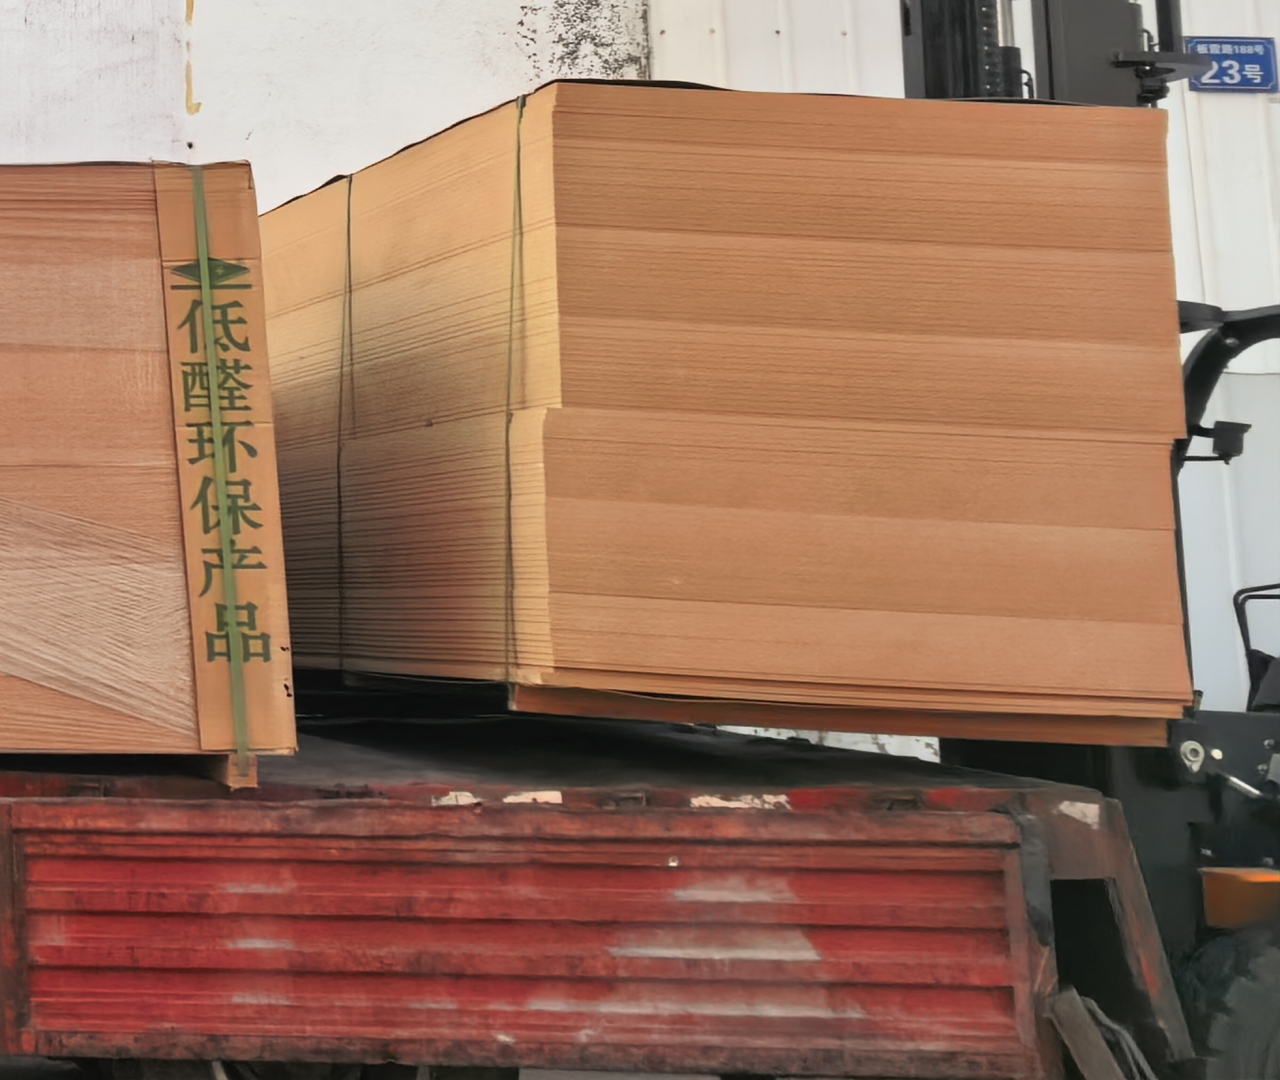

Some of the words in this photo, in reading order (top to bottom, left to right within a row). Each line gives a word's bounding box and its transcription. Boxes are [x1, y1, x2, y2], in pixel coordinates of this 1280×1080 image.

[1200, 60, 1264, 84] 23号
[177, 299, 271, 663] 低醛环保产品
